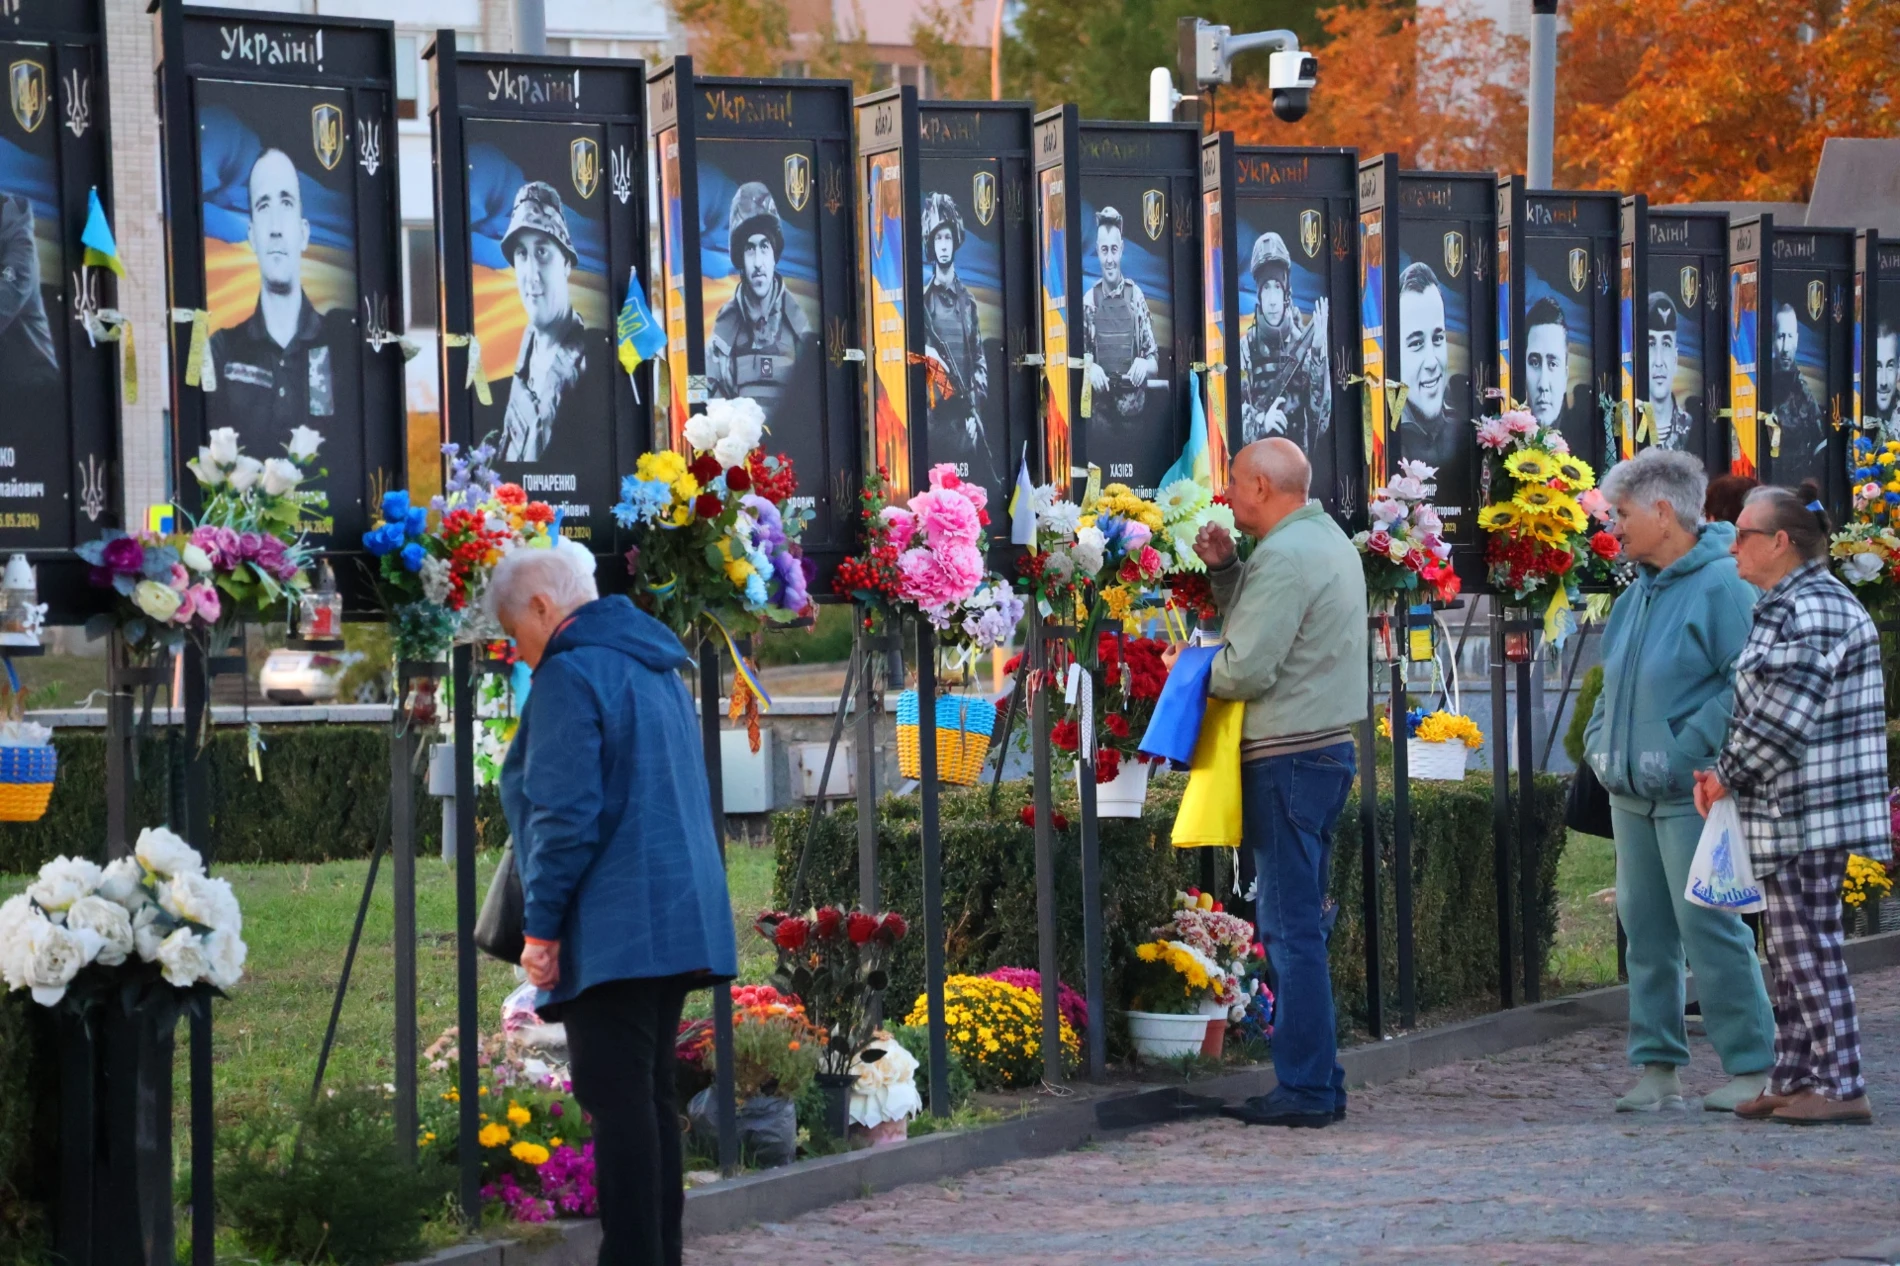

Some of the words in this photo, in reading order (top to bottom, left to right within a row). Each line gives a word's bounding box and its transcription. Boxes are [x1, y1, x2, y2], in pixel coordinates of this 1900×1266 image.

[221, 26, 323, 72] Україні!
[488, 68, 579, 109] Україні!
[705, 90, 792, 127] Україні!
[523, 474, 576, 492] ГОНЧАРЕНКО
[1109, 463, 1133, 478] ХАЗІЄВ
